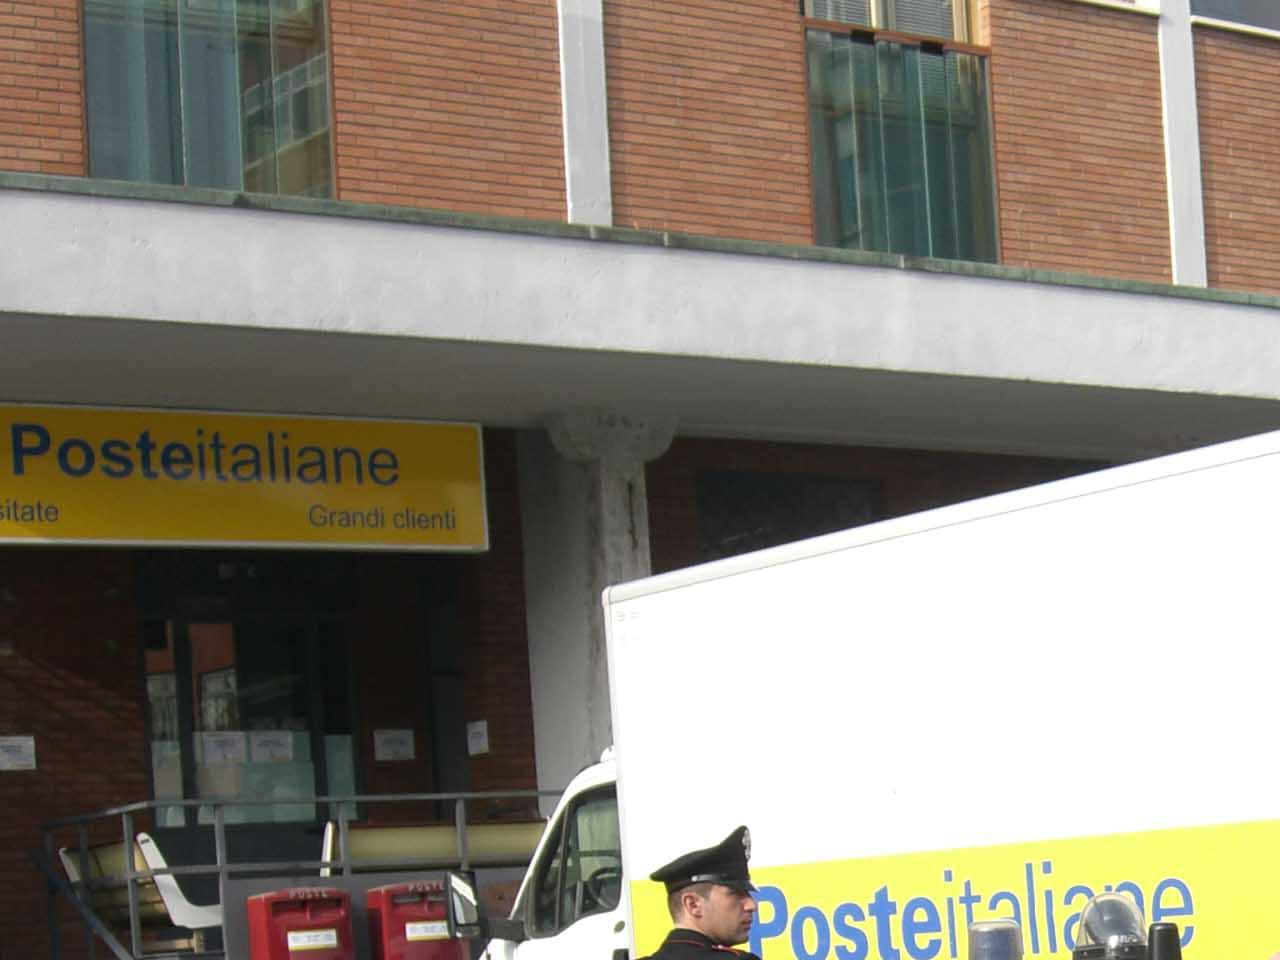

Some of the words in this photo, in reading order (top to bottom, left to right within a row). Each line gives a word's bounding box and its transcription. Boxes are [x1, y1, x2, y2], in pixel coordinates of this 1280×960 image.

[11, 423, 400, 486] Posteitaliane
[308, 504, 385, 530] Grandi
[392, 507, 457, 531] clienti
